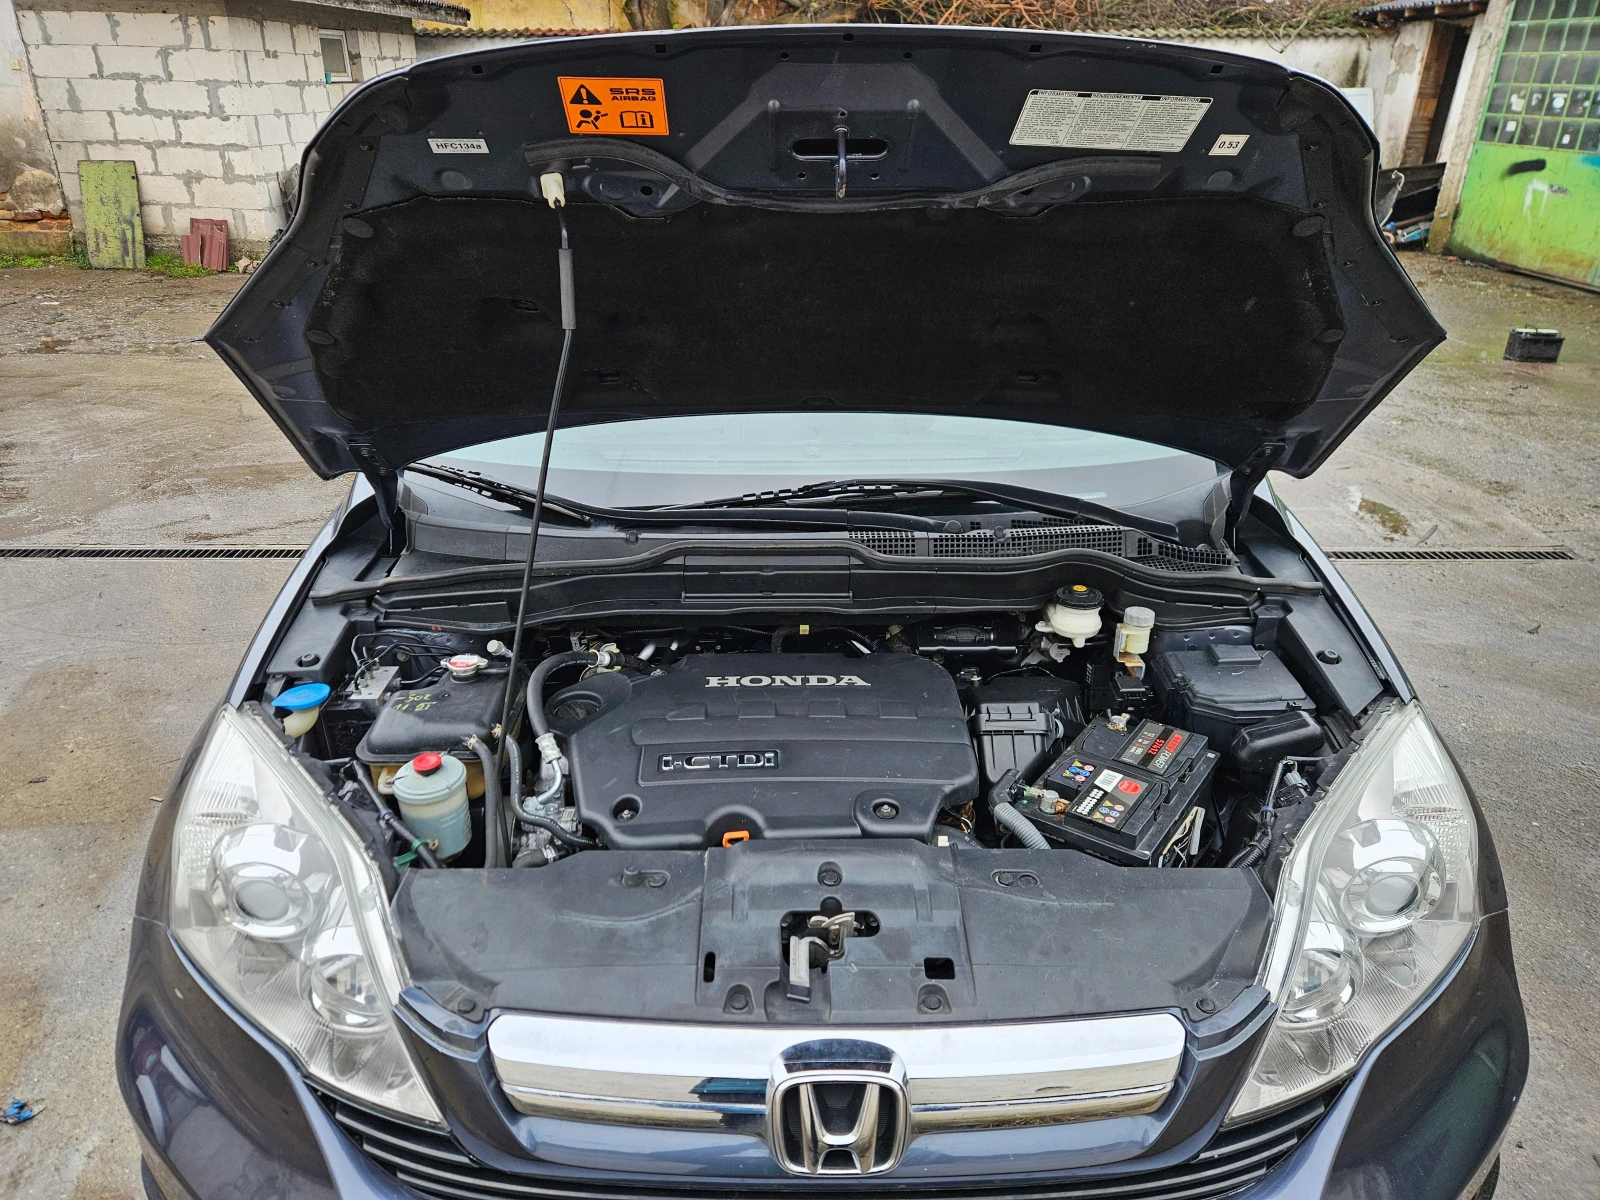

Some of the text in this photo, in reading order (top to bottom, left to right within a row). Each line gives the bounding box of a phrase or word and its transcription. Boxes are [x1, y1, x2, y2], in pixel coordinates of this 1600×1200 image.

[609, 87, 656, 95] SRS
[435, 142, 482, 150] HFC134a
[1218, 140, 1241, 149] 0.53
[705, 675, 872, 688] HONDA
[1153, 749, 1172, 769] POWER
